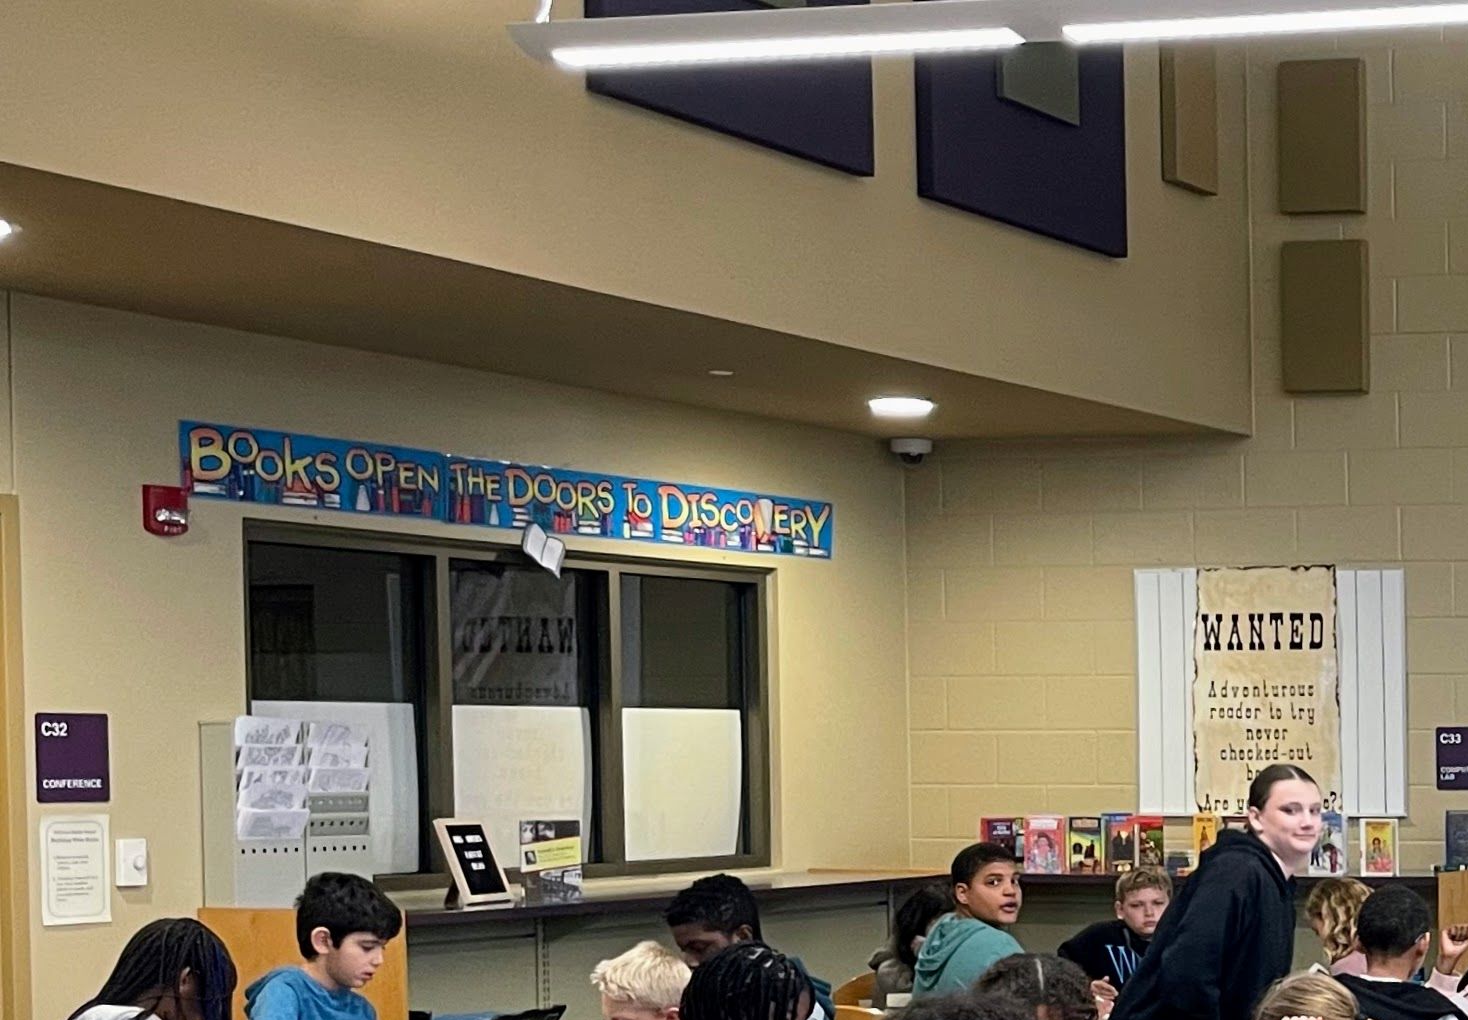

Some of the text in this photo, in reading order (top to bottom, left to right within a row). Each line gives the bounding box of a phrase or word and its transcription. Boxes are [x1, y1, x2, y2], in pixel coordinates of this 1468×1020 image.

[345, 447, 440, 494] OPEN
[450, 462, 502, 502] THE
[504, 467, 615, 518] DOORS
[622, 482, 653, 518] TO
[657, 484, 830, 547] DISCOVERY
[1201, 612, 1324, 650] WANTED
[1208, 680, 1314, 698] Adventurous
[1210, 701, 1315, 725] reader to try
[41, 722, 68, 737] C32
[1246, 729, 1288, 740] never
[1440, 733, 1461, 744] C33
[1220, 742, 1313, 760] checked-out
[43, 779, 102, 789] CONFERENCE
[1204, 793, 1228, 811] Are
